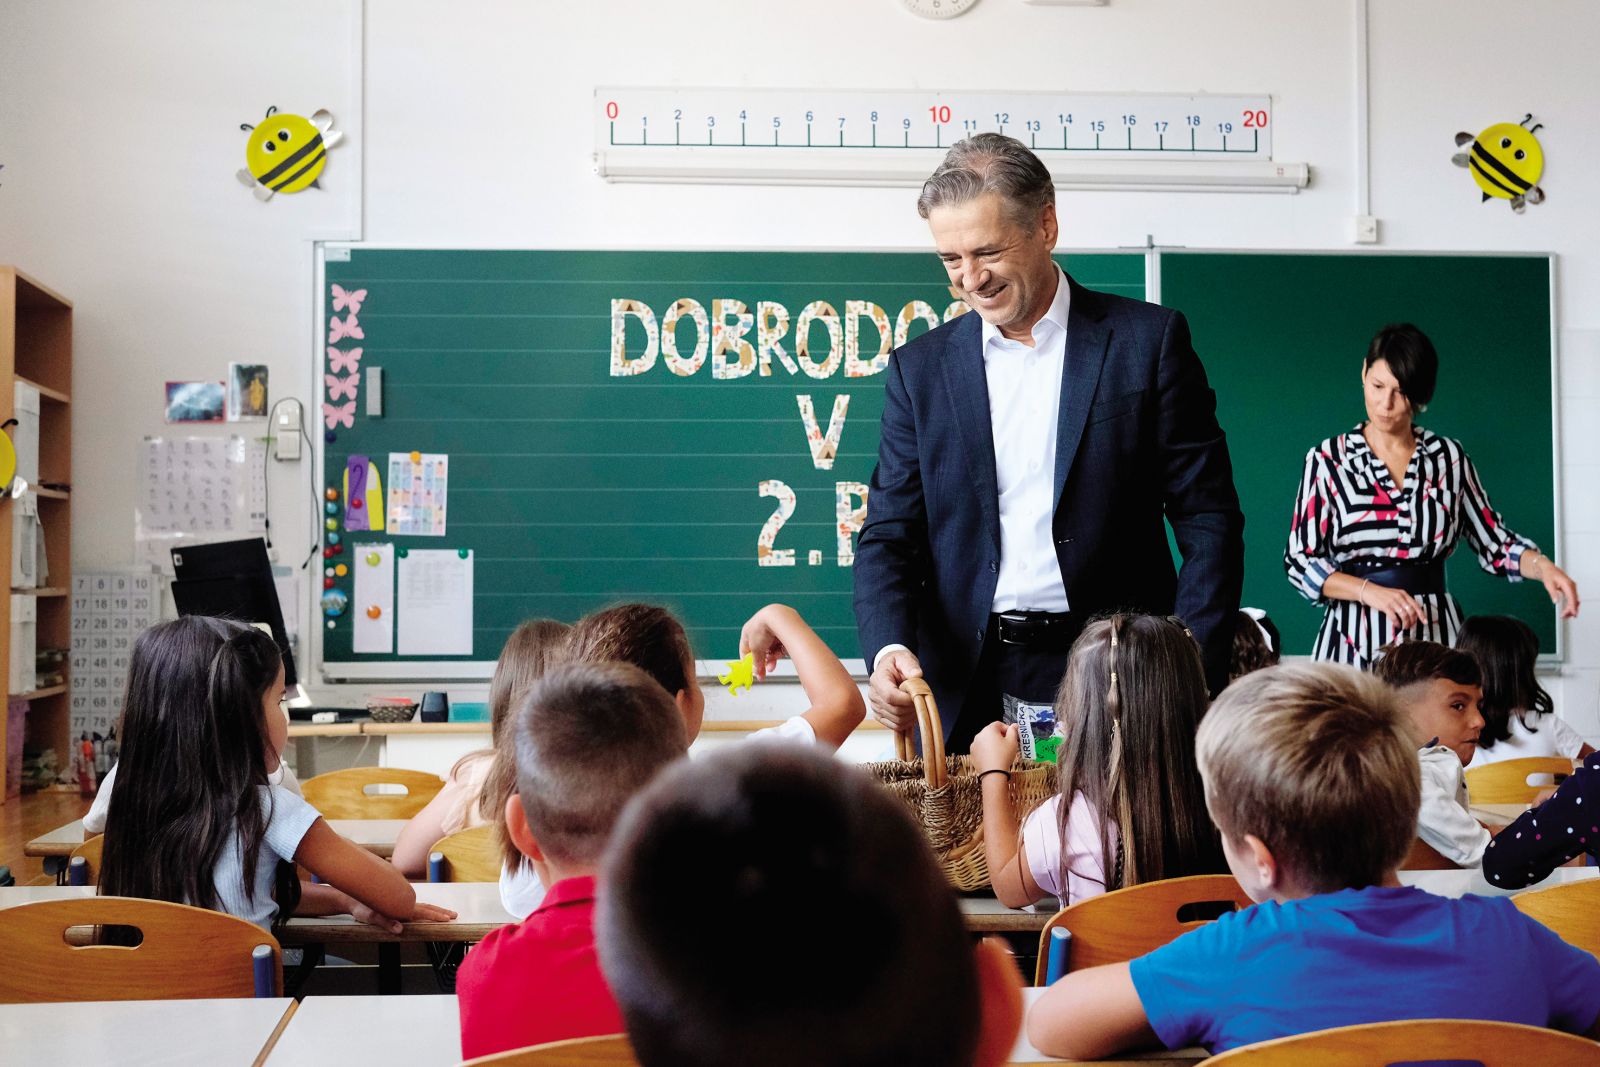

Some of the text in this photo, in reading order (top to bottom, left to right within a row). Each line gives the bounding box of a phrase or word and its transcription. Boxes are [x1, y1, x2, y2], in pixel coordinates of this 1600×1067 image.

[606, 101, 619, 119] 0
[674, 109, 682, 120] 2
[707, 116, 715, 127] 3
[739, 110, 747, 120] 4
[773, 117, 781, 128] 5
[805, 111, 813, 122] 6
[838, 118, 846, 128] 7
[870, 111, 878, 122] 8
[903, 118, 911, 129] 9
[928, 106, 951, 123] 10
[964, 120, 977, 130] 11
[994, 113, 1009, 124] 12
[1026, 121, 1041, 132] 13
[1059, 114, 1073, 124] 14
[1090, 121, 1105, 132] 15
[1122, 115, 1137, 126] 16
[1154, 122, 1168, 133] 17
[1186, 116, 1201, 126] 18
[1218, 123, 1232, 134] 19
[1243, 110, 1268, 128] 20
[796, 394, 850, 470] V
[77, 579, 148, 590] 7 8 9 10
[75, 599, 148, 609] 17 18 19 20
[74, 618, 87, 629] 27
[94, 618, 107, 629] 28
[114, 618, 128, 629] 29
[74, 638, 128, 649] 37 38 39
[74, 658, 86, 668] 47
[94, 658, 107, 668] 48
[73, 677, 86, 688] 57
[94, 677, 107, 688] 58
[73, 697, 86, 708] 67
[93, 697, 107, 708] 68
[74, 717, 107, 727] 77 78
